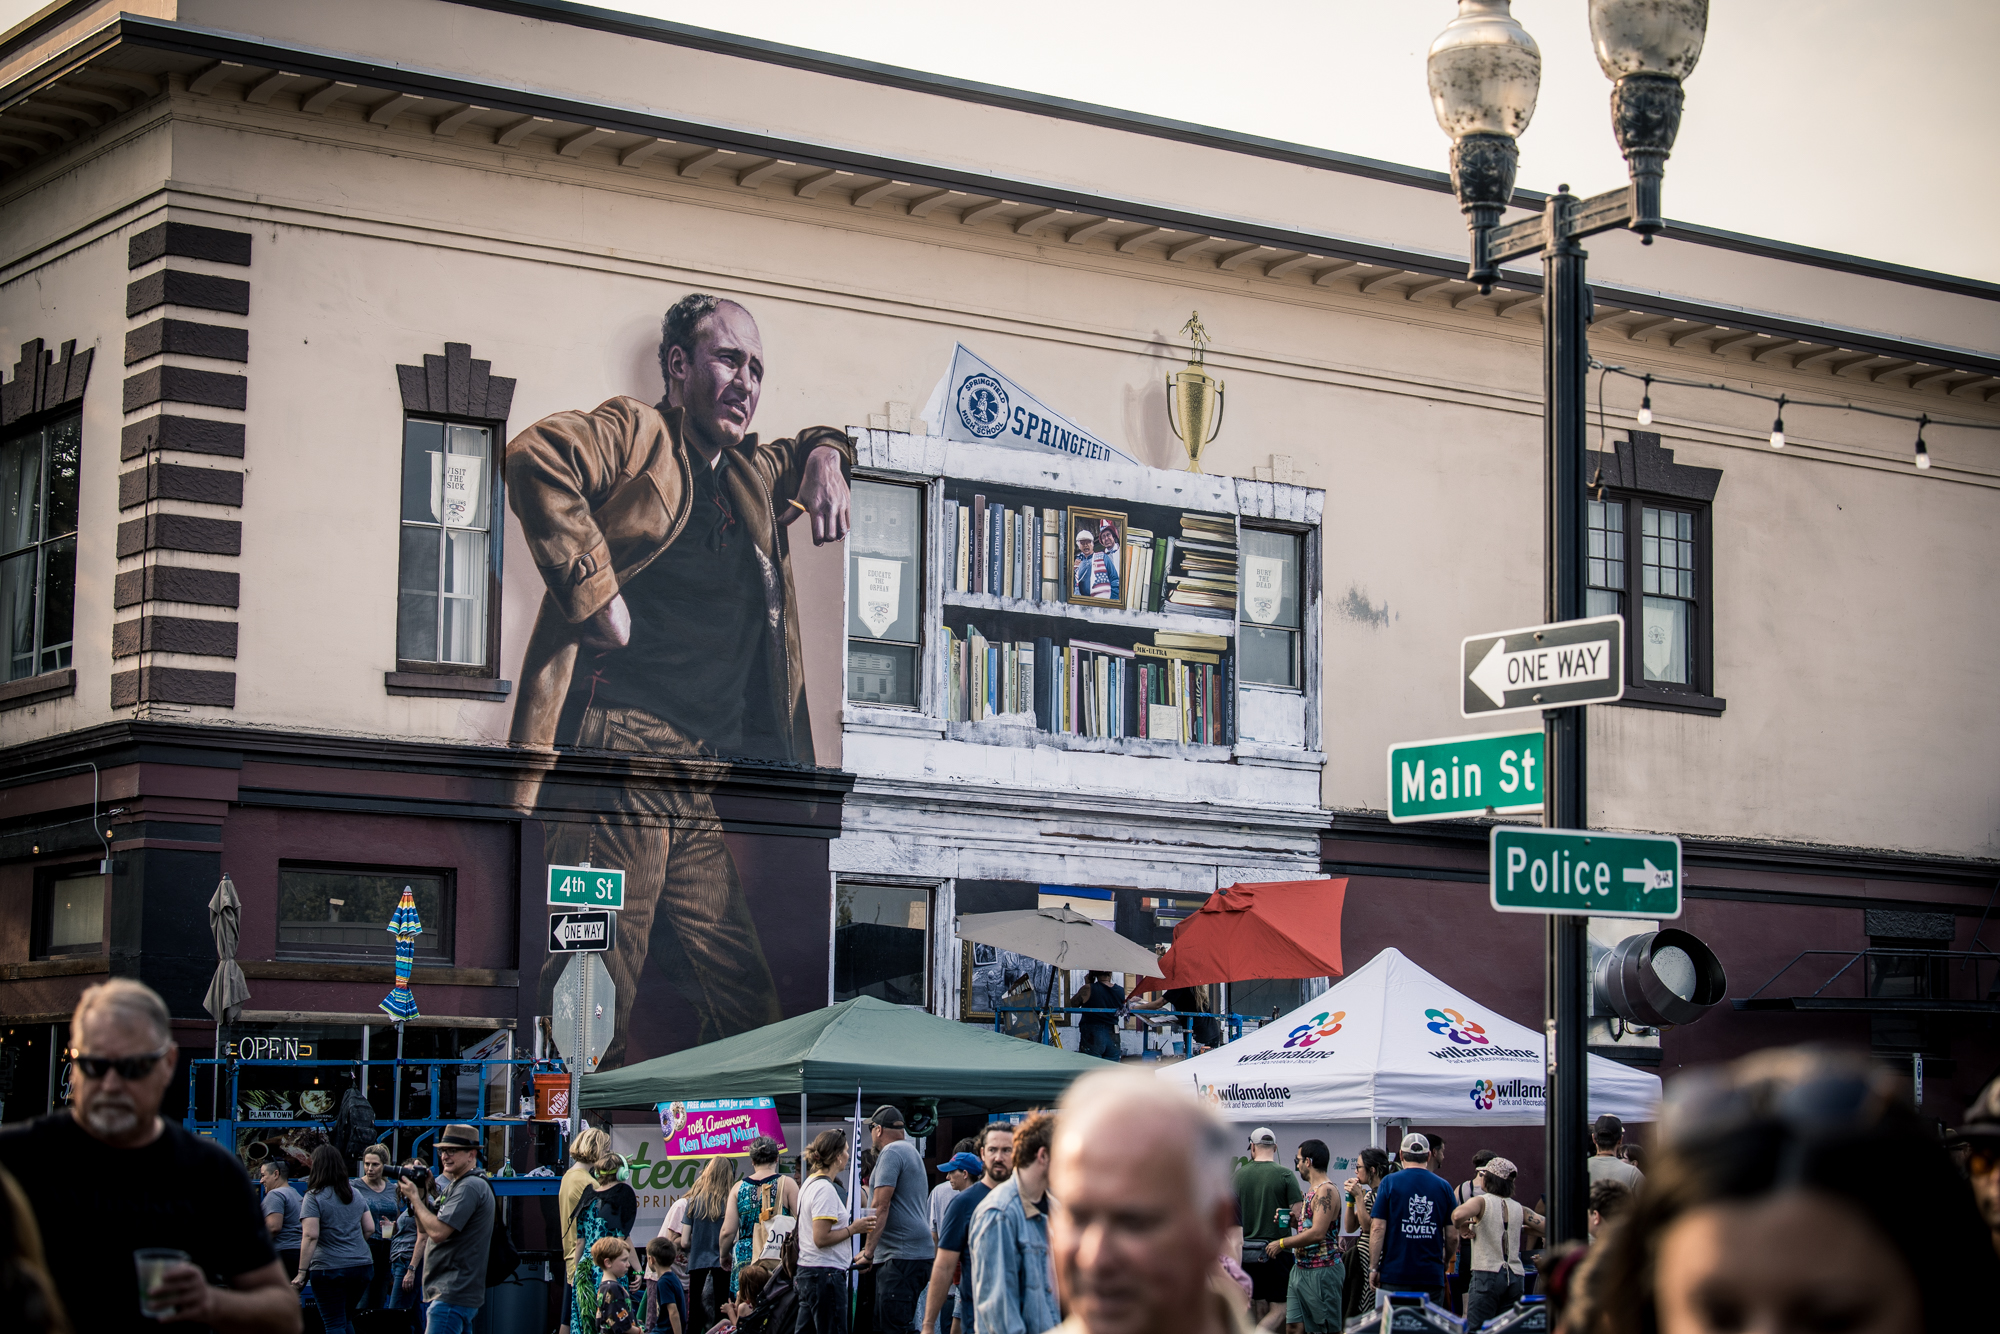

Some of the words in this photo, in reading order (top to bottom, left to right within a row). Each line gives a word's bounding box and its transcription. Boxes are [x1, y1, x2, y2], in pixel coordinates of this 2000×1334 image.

[965, 378, 1005, 404] SPRINGFIELD
[962, 410, 975, 429] HIGH
[977, 422, 1004, 435] SCHOOL
[447, 482, 465, 490] SICK
[868, 570, 891, 579] EDUCATE
[870, 584, 889, 592] ORPHAN
[1508, 654, 1548, 685] ONE
[1557, 645, 1602, 678] WAY
[1401, 756, 1482, 803] Main
[1499, 748, 1536, 794] St
[1507, 847, 1610, 896] Police
[559, 876, 585, 897] 4th
[595, 878, 613, 900] St
[565, 925, 581, 939] ONE
[584, 924, 602, 938] WAY
[240, 1037, 299, 1060] OPEN
[1238, 1048, 1335, 1063] willamalane
[1428, 1045, 1539, 1059] willamalane
[1218, 1083, 1291, 1101] willamalane
[1497, 1080, 1547, 1098] willama
[549, 1089, 569, 1115] HOM
[687, 1101, 699, 1109] FREE
[700, 1100, 716, 1108] donuts!
[719, 1100, 730, 1108] SPIN
[730, 1099, 738, 1109] for
[273, 1111, 293, 1119] TOWN
[687, 1118, 705, 1136] 10th
[706, 1114, 751, 1133] Anniversary
[679, 1137, 699, 1153] Ken
[700, 1132, 731, 1149] Kesey
[731, 1123, 760, 1143] Mural
[1401, 1223, 1437, 1235] LOVELY
